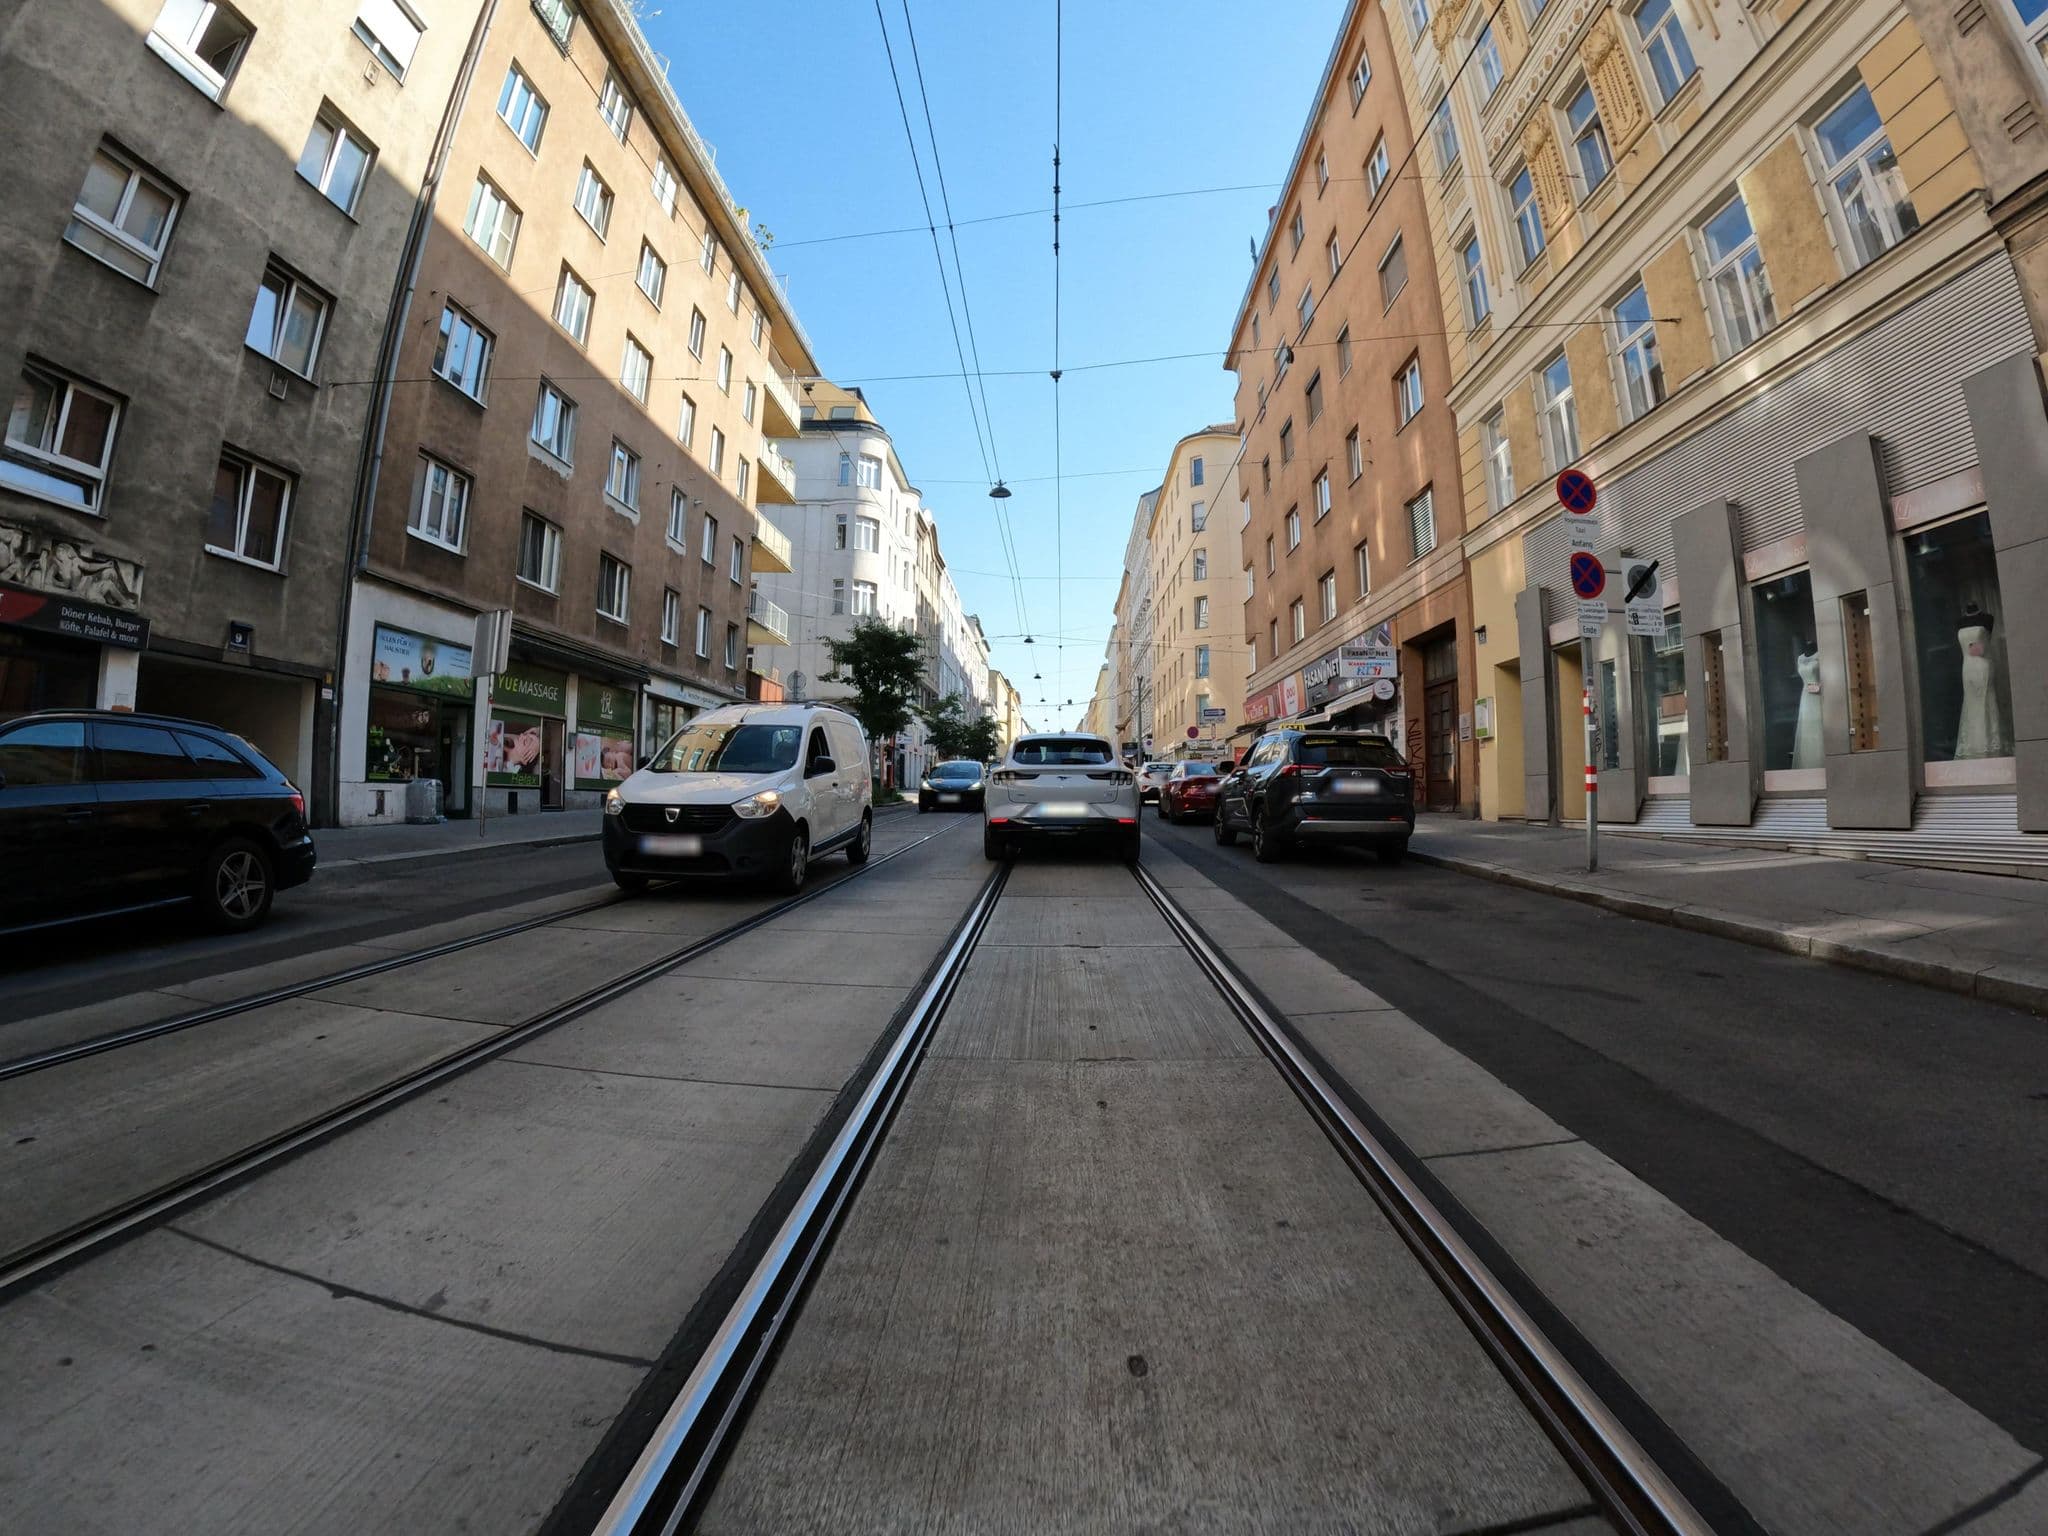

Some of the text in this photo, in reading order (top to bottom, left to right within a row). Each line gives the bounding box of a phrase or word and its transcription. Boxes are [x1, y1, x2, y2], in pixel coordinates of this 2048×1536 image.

[1571, 539, 1594, 549] Anfang
[61, 606, 140, 632] Döner Kebab, Burger
[84, 625, 110, 638] Falafel
[110, 630, 117, 640] &
[119, 634, 139, 644] more
[1582, 625, 1597, 635] Ende
[235, 632, 243, 644] 9
[1327, 658, 1340, 679] NET
[511, 773, 537, 785] Relax
